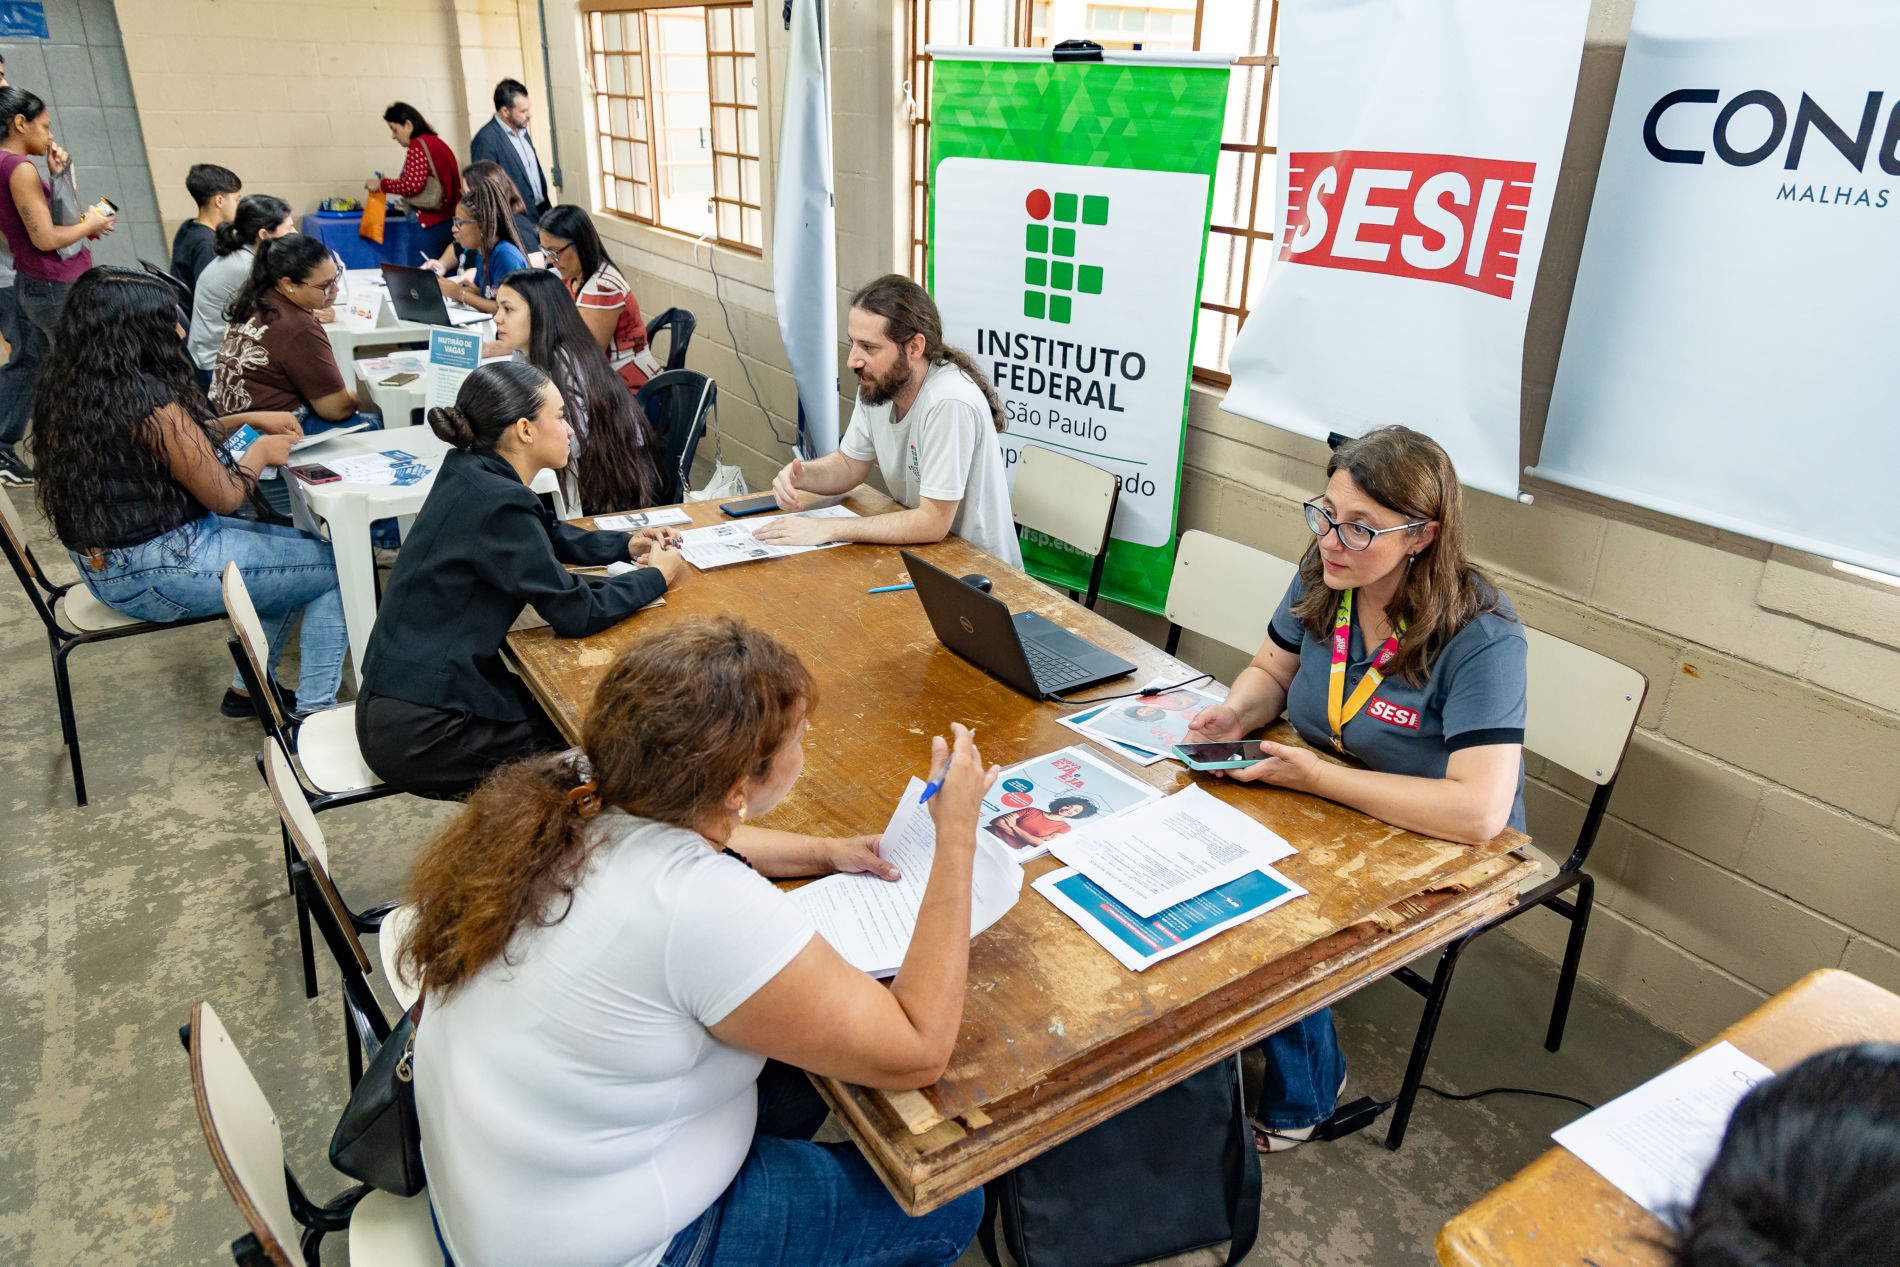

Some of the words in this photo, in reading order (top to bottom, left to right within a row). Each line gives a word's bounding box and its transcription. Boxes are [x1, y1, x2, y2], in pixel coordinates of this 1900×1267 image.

[1776, 183, 1890, 209] MALHAS
[1290, 165, 1505, 278] SESI
[444, 345, 466, 355] VAGAS
[977, 328, 1146, 381] INSTITUTO
[993, 361, 1125, 413] FEDERAL
[1005, 399, 1041, 426] São
[1049, 409, 1107, 442] Paulo
[1370, 701, 1417, 727] SESI
[1058, 772, 1085, 789] EJA
